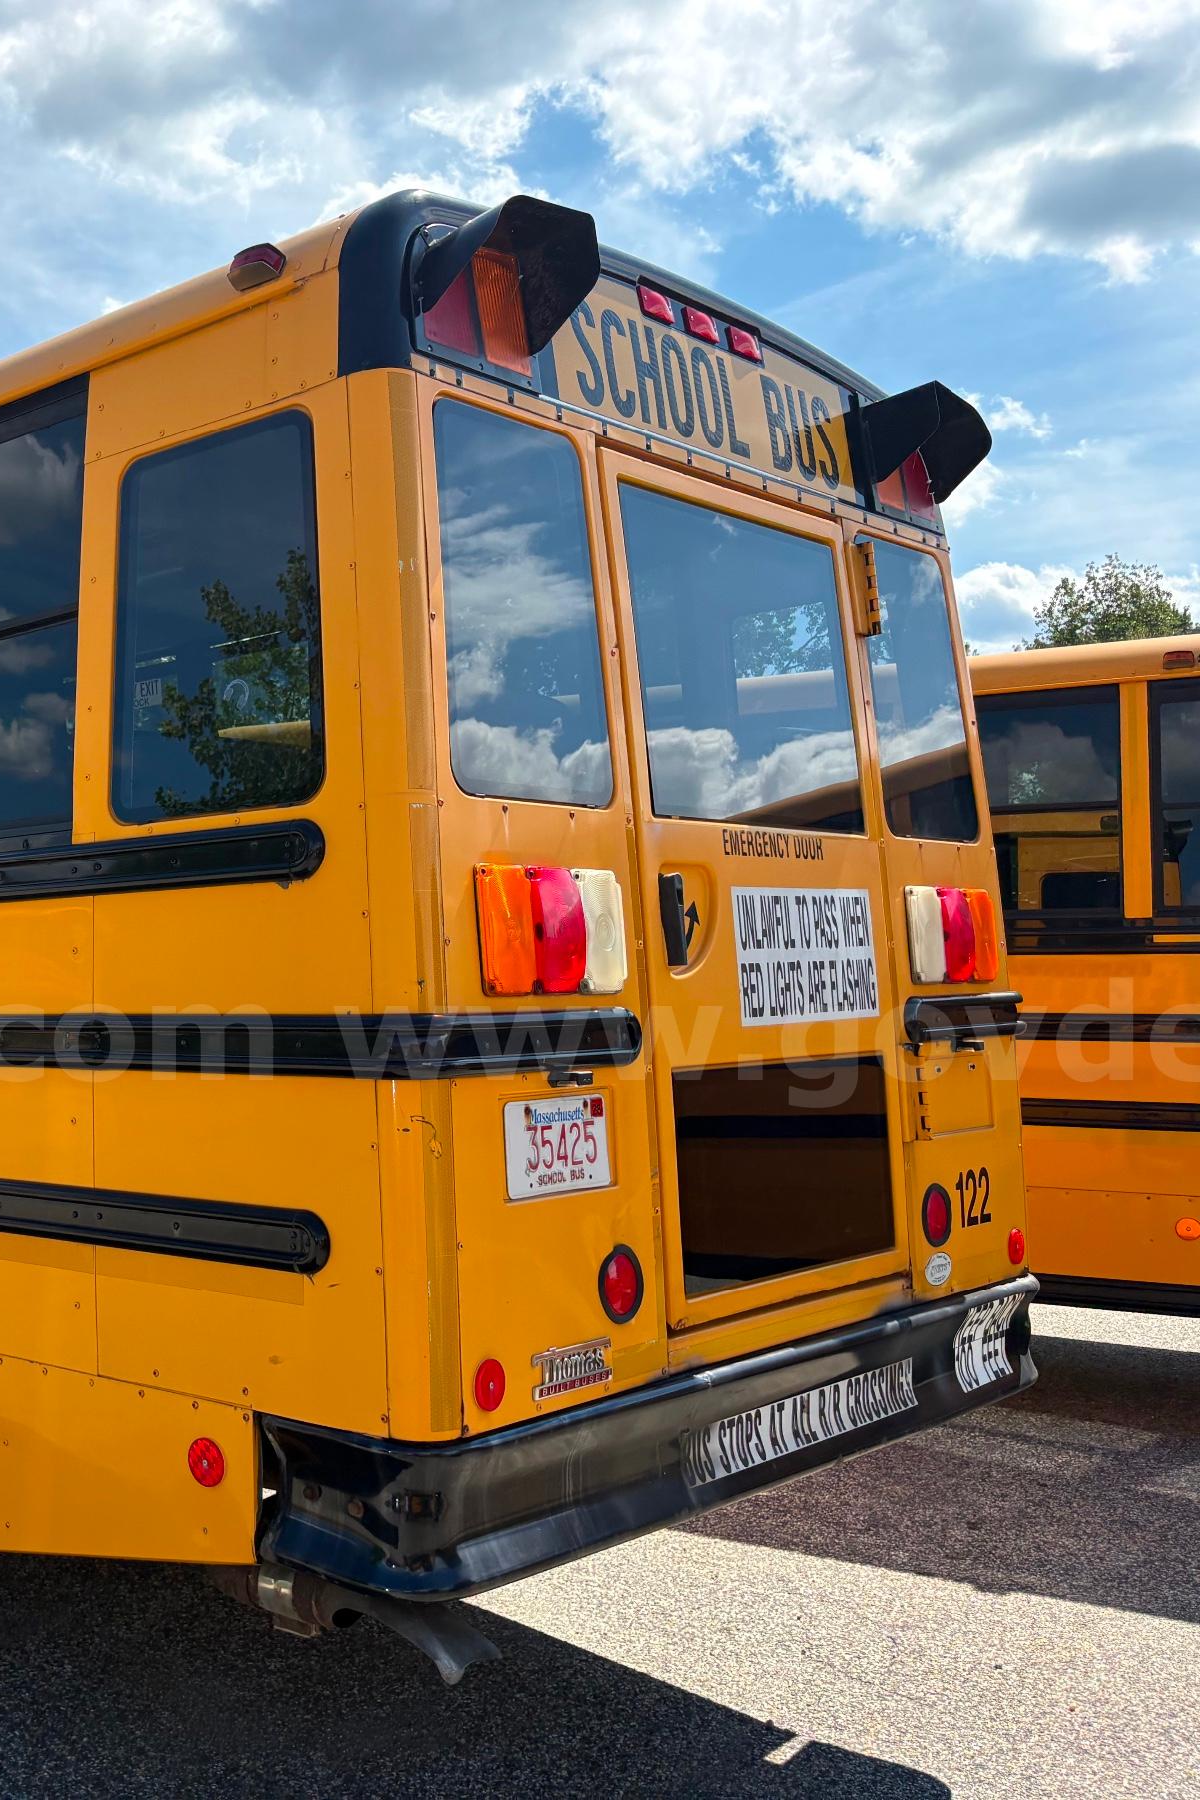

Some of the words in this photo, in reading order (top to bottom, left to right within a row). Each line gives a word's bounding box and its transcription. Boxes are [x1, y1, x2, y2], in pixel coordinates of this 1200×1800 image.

[569, 299, 750, 459] SCHOOL
[760, 374, 840, 490] BUS
[140, 680, 159, 697] EXIT
[722, 829, 792, 859] EMERGENCY
[736, 894, 796, 950] UNLAWFUL
[795, 894, 811, 949] TO
[812, 894, 839, 949] PASS
[839, 896, 870, 948] WHEN
[741, 962, 765, 1018] RED
[767, 959, 804, 1017] LIGHTS
[807, 960, 828, 1014] ARE
[829, 957, 878, 1013] FLASHING
[529, 1106, 585, 1126] Massachusetts
[525, 1120, 597, 1173] 35425
[537, 1170, 567, 1187] SCHOOL
[570, 1168, 585, 1181] BUS
[955, 1167, 991, 1228] 122
[532, 1338, 611, 1385] Thomas
[982, 1328, 1013, 1382] FEET
[542, 1381, 571, 1397] BUILT
[574, 1371, 607, 1388] BUSES
[680, 1424, 716, 1486] BUS
[717, 1408, 767, 1474] STOPS
[769, 1401, 789, 1456] AT
[791, 1393, 819, 1448] ALL
[818, 1384, 846, 1438] R/R
[846, 1359, 916, 1428] CROSSINGS
